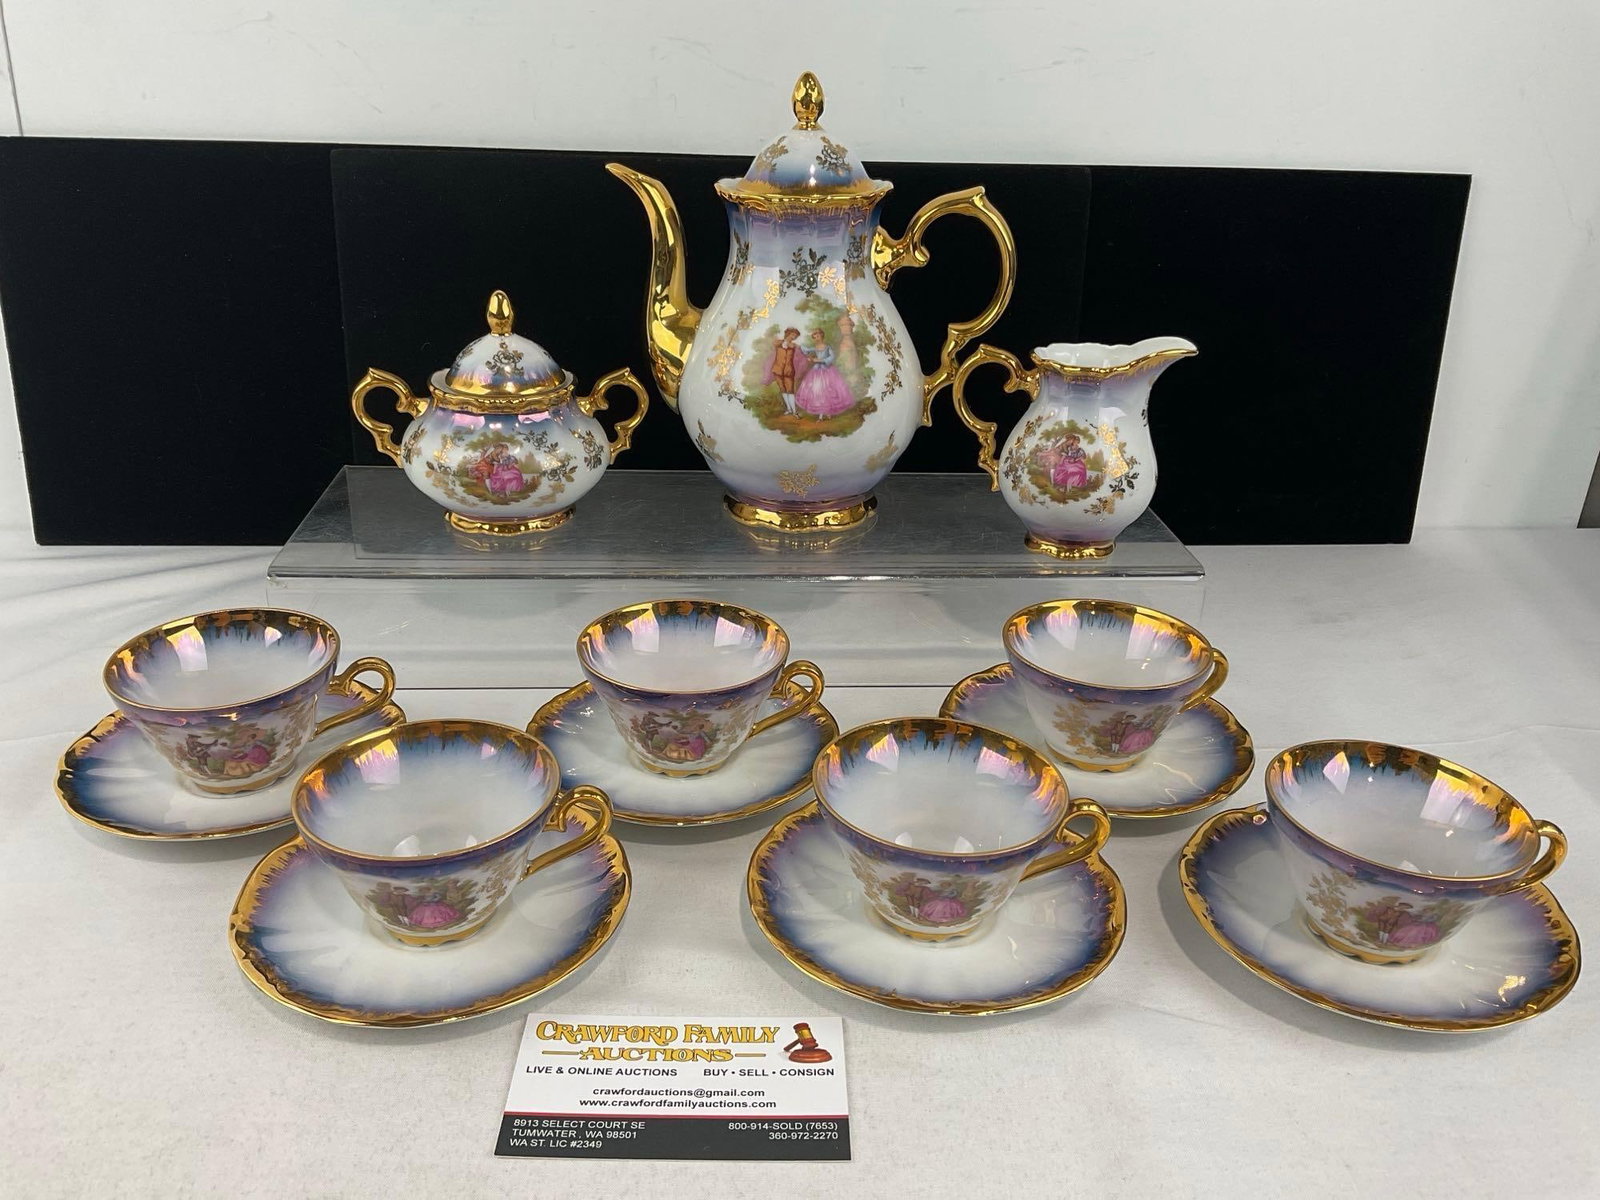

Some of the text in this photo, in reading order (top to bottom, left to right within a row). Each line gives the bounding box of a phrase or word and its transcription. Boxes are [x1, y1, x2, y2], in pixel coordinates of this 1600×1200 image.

[536, 1021, 780, 1046] CRAWFORD FAMILY
[579, 1047, 733, 1062] AUCTIONS
[525, 1065, 678, 1077] LIVE & ONLINE AUCTIONS
[703, 1068, 835, 1077] BUY SELL CONSIGN
[592, 1087, 765, 1099] crawfordauctions@gmail.com
[579, 1098, 777, 1110] www.crawfordfamilyauctions.com
[513, 1118, 646, 1130] 8913 SELECT COURT SE
[728, 1121, 838, 1131] 800-914-SOLD (7653)
[512, 1128, 577, 1138] TUMWATER
[585, 1130, 604, 1139] WA
[605, 1130, 638, 1140] 98501
[768, 1131, 839, 1140] 360-972-2270
[509, 1138, 528, 1147] WA
[549, 1139, 568, 1148] LIC
[569, 1139, 603, 1149] #2349
